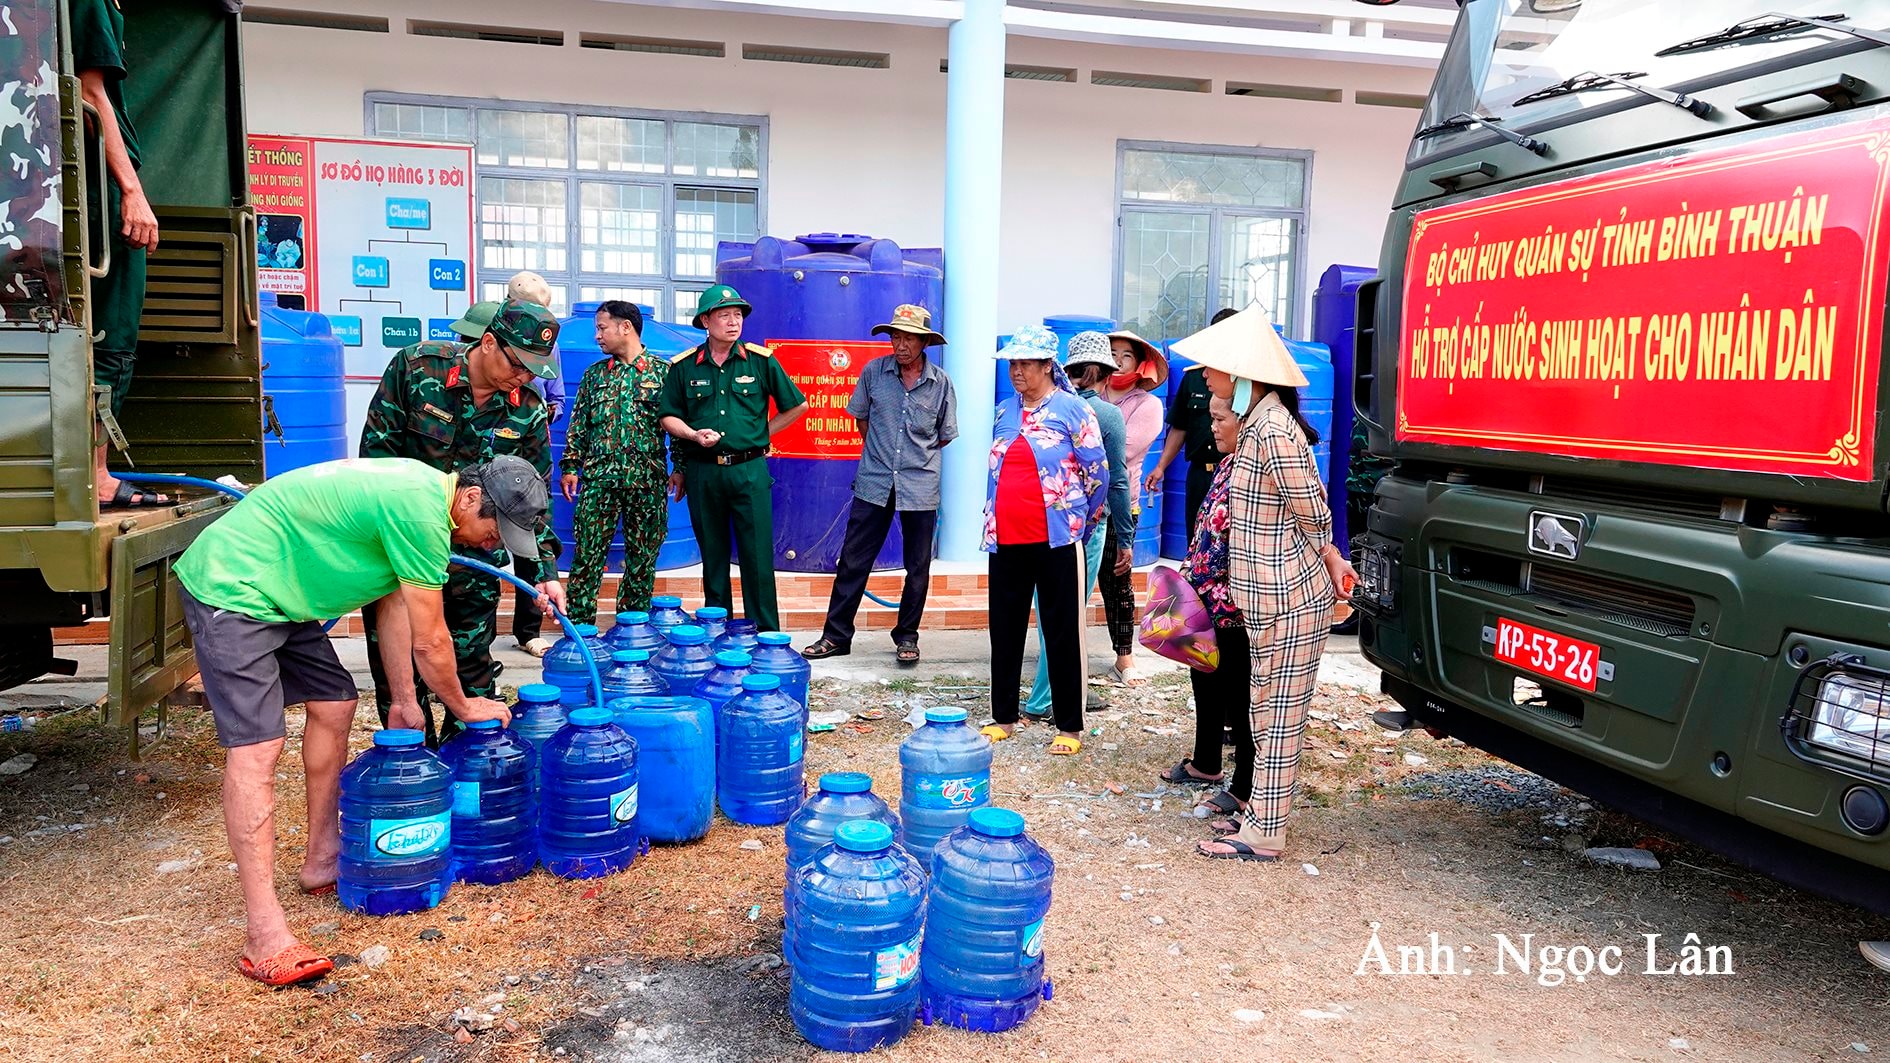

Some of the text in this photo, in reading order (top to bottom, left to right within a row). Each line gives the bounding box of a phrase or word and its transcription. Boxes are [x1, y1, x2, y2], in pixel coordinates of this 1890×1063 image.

[247, 143, 303, 166] ẾT THỐNG
[249, 173, 259, 185] NH
[270, 175, 277, 186] DI
[321, 159, 464, 187] SƠ ĐỒ HỌ HÀNG 3 ĐỜI
[280, 191, 304, 207] GIỐNG
[389, 204, 427, 221] Cha/mẹ
[1425, 185, 1828, 297] BỘ CHỈ HUY QUÂN SỰ TỈNH BÌNH THUẬN
[356, 263, 385, 278] Con 1
[433, 267, 461, 281] Con 2
[383, 327, 419, 337] Cháu 1b
[430, 328, 453, 338] Cháu
[1410, 288, 1838, 400] HỖ TRỢ CẤP NƯỚC SINH HOẠT CHO NHÂN DÂN
[801, 375, 815, 384] HUY
[809, 389, 852, 409] CẤP NƯỚ
[806, 418, 823, 432] CHO
[826, 415, 851, 432] NHÂN
[832, 437, 837, 446] 5
[1497, 622, 1594, 684] KP-53-26
